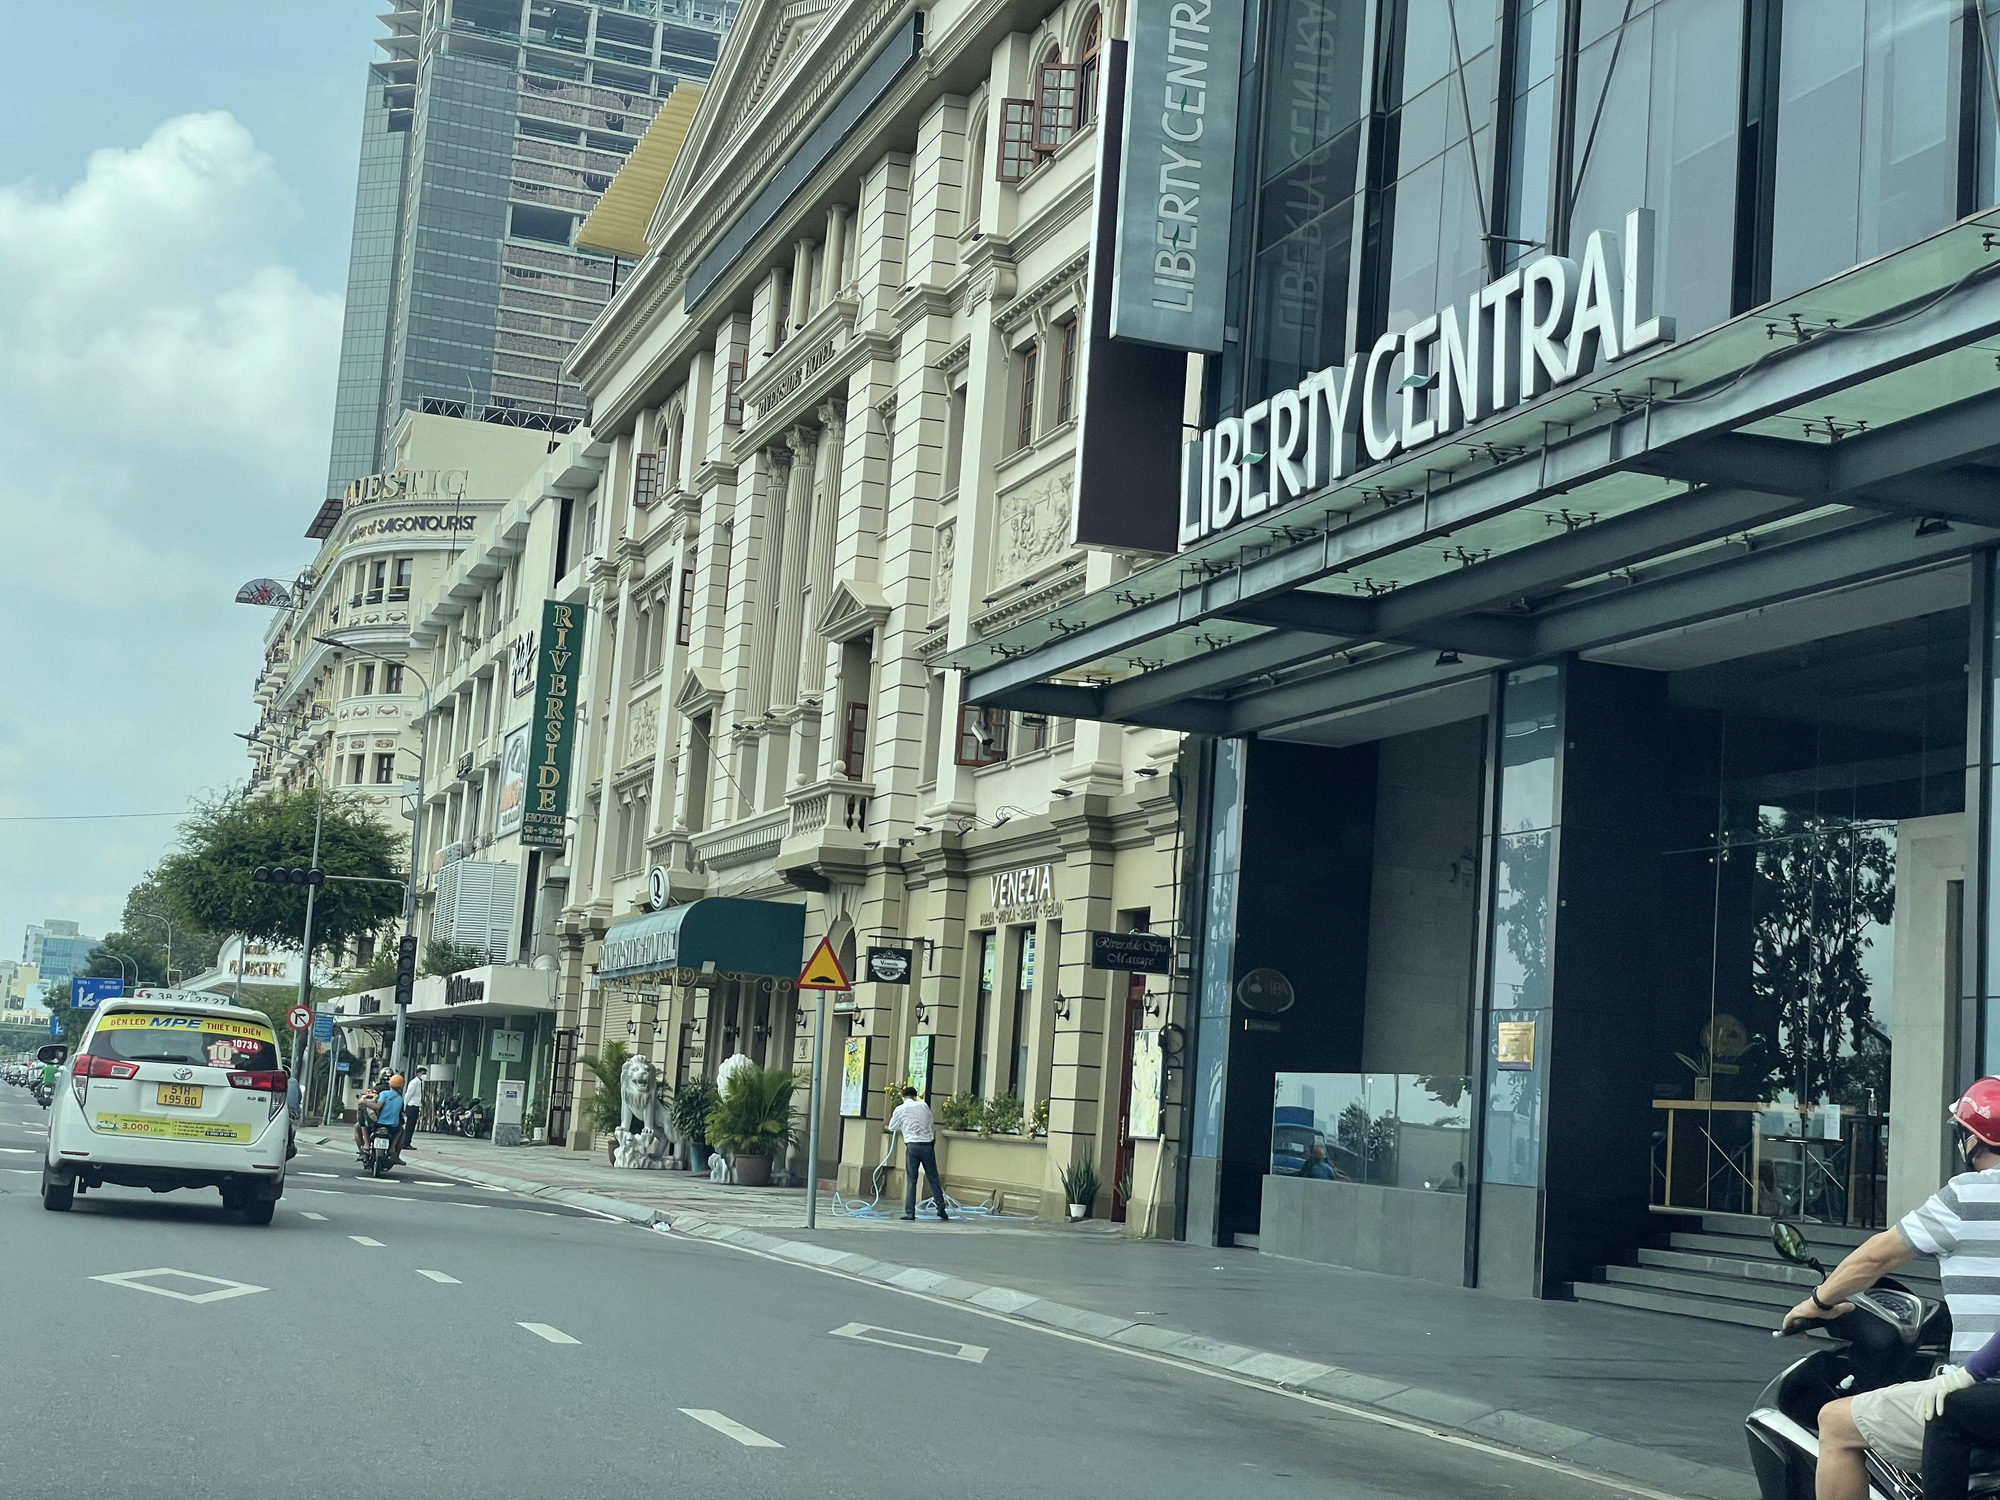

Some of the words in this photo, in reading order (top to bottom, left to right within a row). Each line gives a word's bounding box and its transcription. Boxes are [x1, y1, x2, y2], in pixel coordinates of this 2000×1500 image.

[1161, 0, 1212, 142] CENTR
[1152, 144, 1202, 313] LIBERTY
[757, 367, 803, 421] RIVERSIDE
[804, 340, 837, 380] HOTEL
[1180, 352, 1367, 546] LIBERTY
[1363, 208, 1676, 462] CENTRAL
[377, 516, 477, 534] SAIGONTOURIST
[537, 604, 573, 812] RIVERSIDE
[524, 812, 564, 825] HOTEL
[990, 864, 1055, 908] VENEZIA
[597, 938, 643, 973] RIVERSIDE
[643, 930, 676, 964] HOTEL
[1095, 936, 1142, 951] Riverside
[1142, 939, 1168, 957] Spa
[229, 960, 287, 978] MJESTIC
[1107, 952, 1155, 970] Massage
[130, 1018, 146, 1026] LED
[149, 1017, 204, 1029] MPE
[232, 1039, 259, 1051] 10734
[163, 1094, 197, 1106] 195.80
[171, 1086, 190, 1096] 51H
[122, 1122, 150, 1131] 3.000
